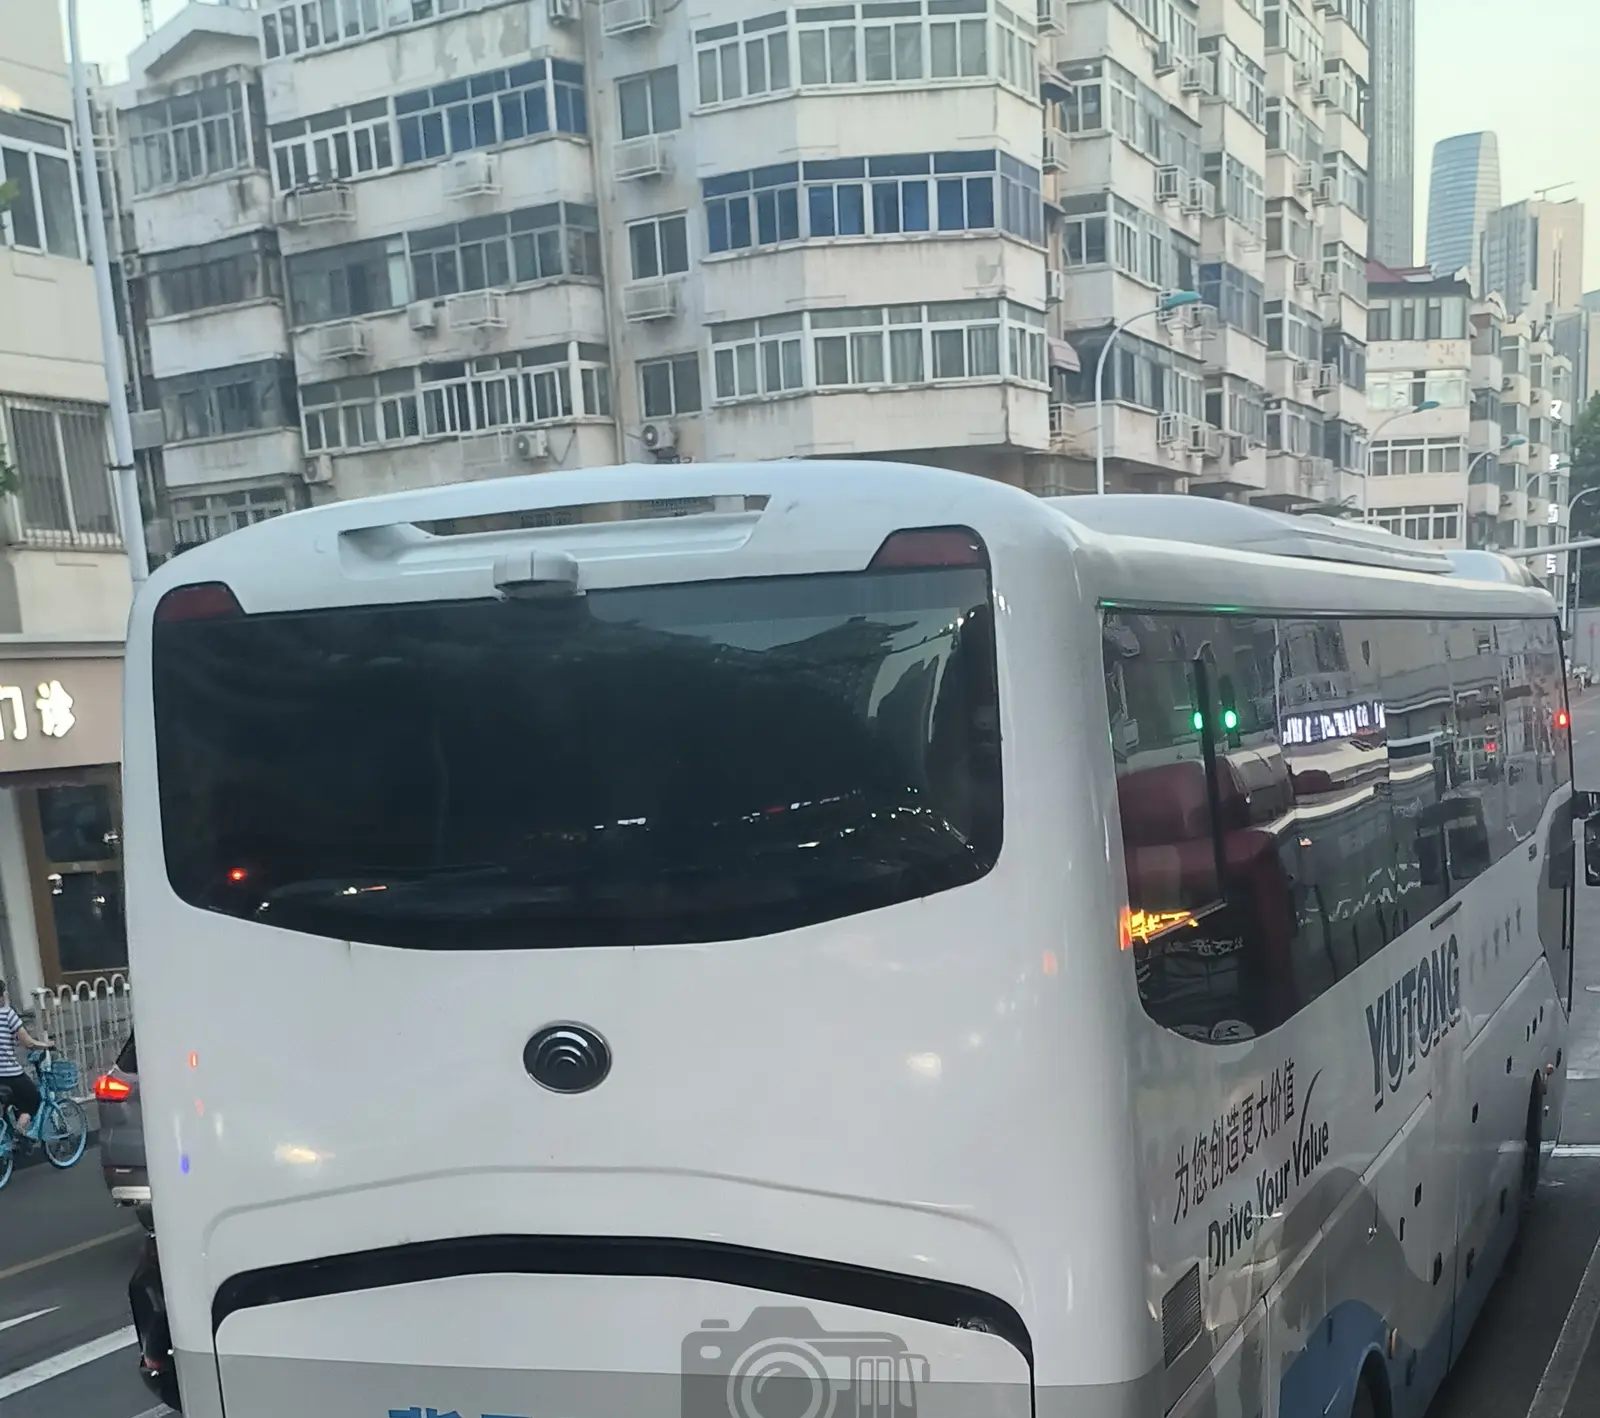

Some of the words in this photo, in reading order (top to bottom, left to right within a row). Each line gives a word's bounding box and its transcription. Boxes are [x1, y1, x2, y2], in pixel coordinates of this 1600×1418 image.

[1365, 933, 1461, 1113] YUTONG
[1173, 1057, 1296, 1225] 为您创造更大价值
[1207, 1199, 1254, 1281] Drive
[1256, 1158, 1291, 1226] Your
